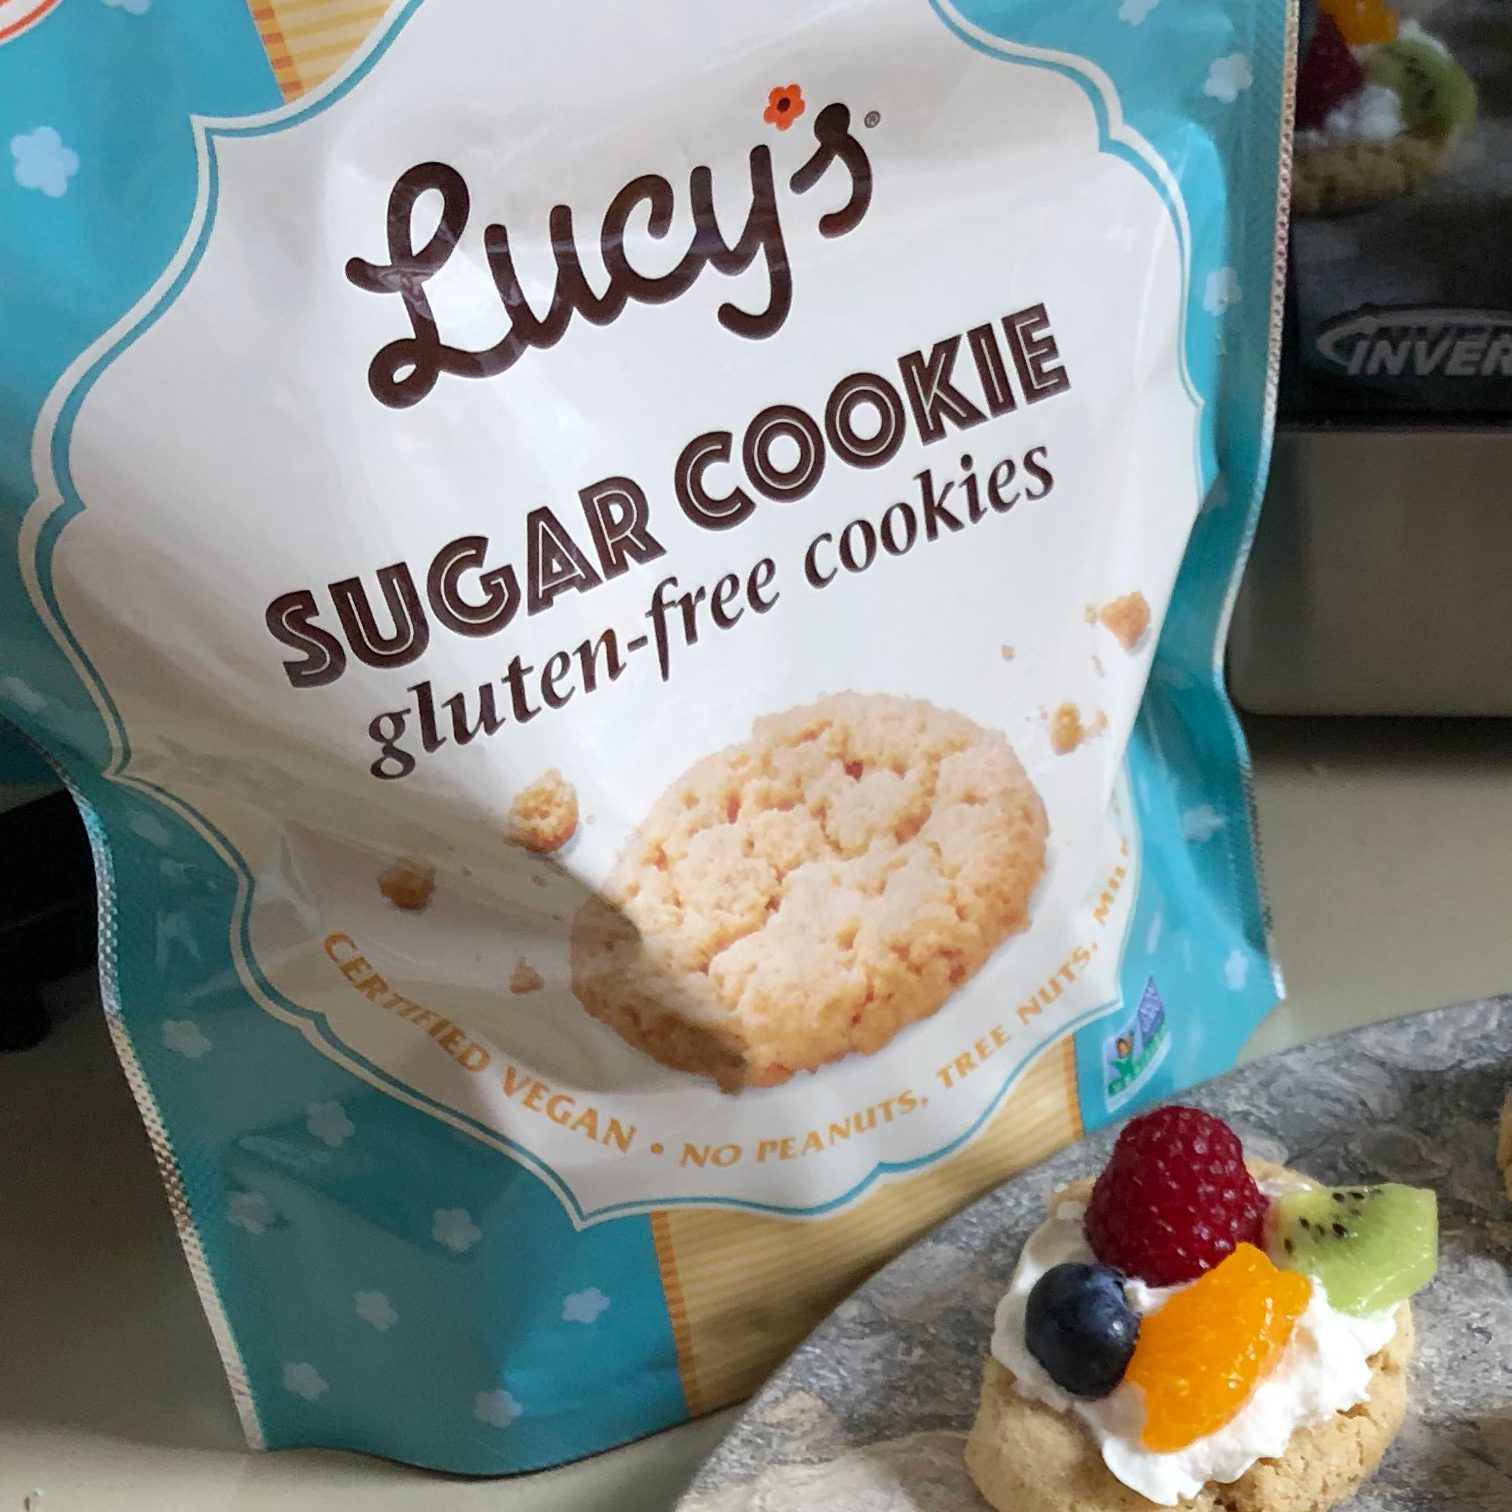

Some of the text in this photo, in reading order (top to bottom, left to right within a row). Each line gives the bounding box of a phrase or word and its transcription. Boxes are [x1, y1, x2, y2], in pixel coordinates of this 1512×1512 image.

[264, 301, 1072, 690] SUGAR COOKIE
[367, 444, 1057, 781] gluten-free cookies
[323, 932, 491, 1073] CERTIFIED
[501, 1065, 638, 1154] VEGAN
[679, 1142, 743, 1169] NO
[756, 1089, 929, 1165] PEANUTS,
[936, 1024, 1012, 1090] TREE
